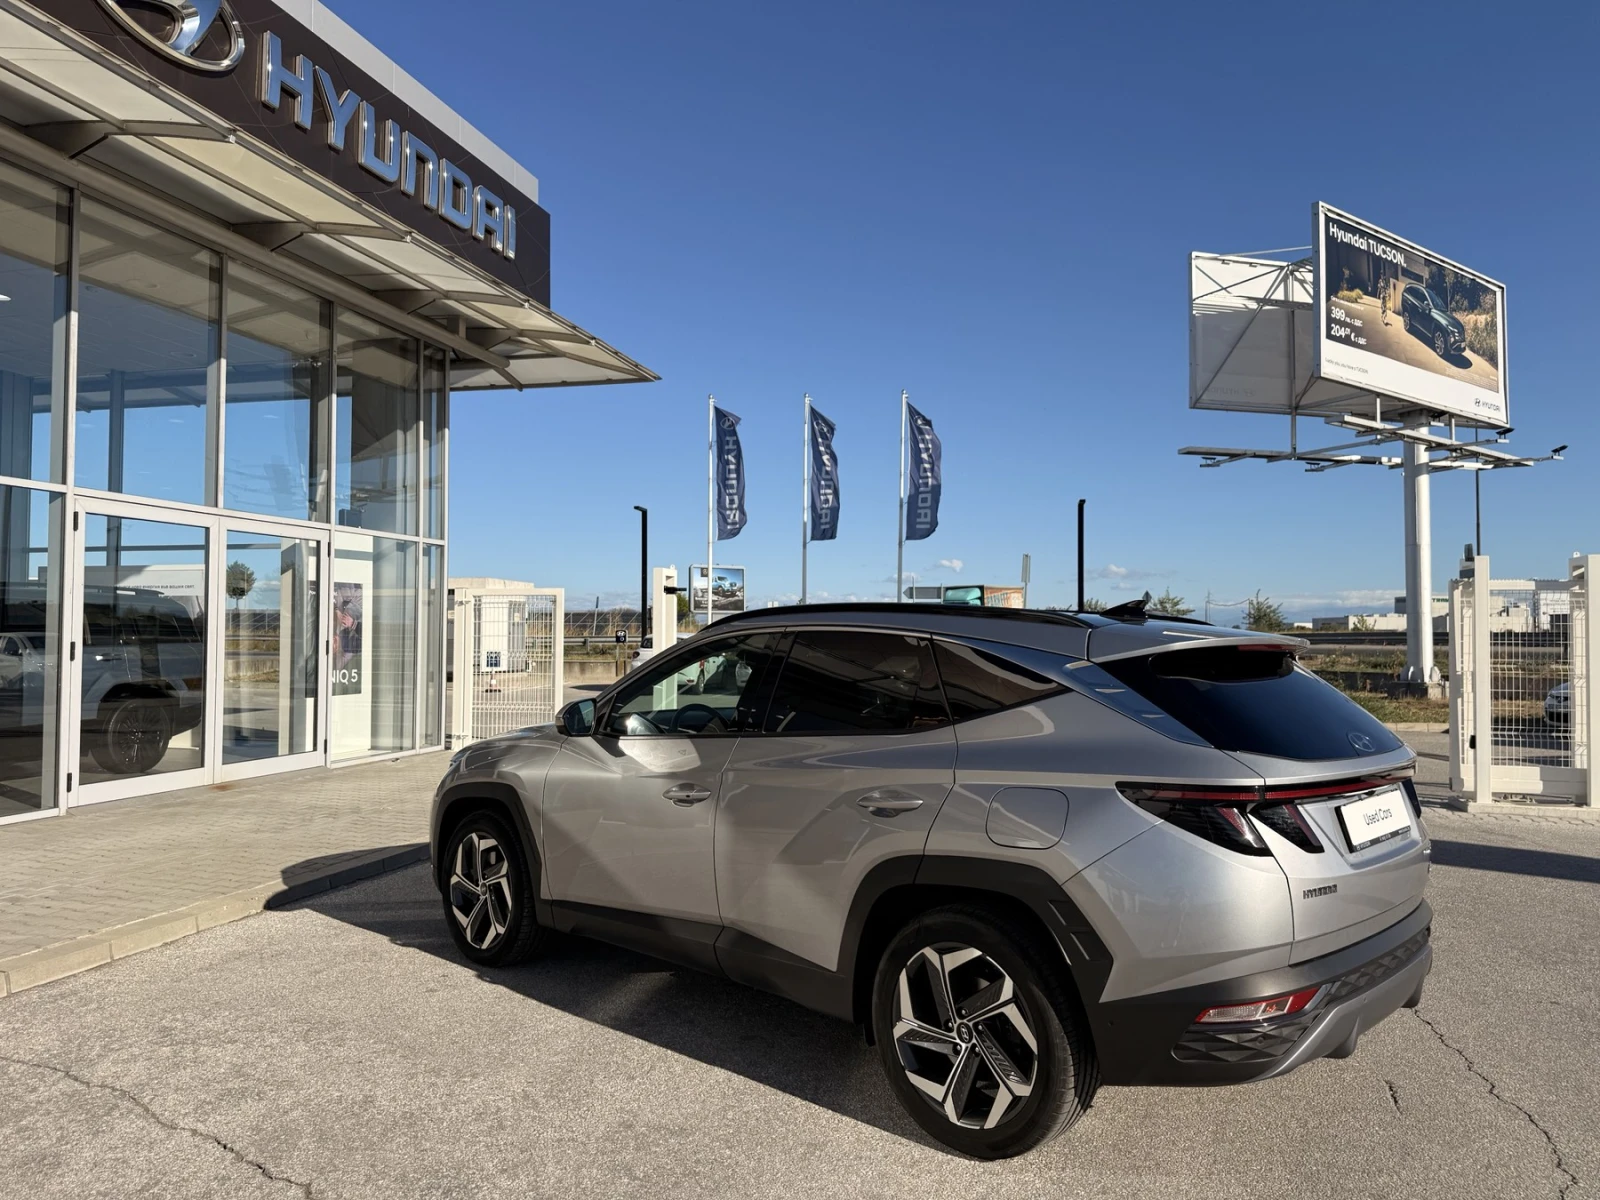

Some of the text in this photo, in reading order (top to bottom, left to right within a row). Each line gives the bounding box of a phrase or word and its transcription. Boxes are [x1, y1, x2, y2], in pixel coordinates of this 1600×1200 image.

[261, 30, 516, 260] HYUNDAI
[1329, 222, 1407, 267] Hyundai TUCSON.
[1331, 306, 1346, 321] 399
[724, 435, 740, 530] HYUNDAI
[915, 434, 933, 530] HYUNDAI
[351, 669, 359, 683] 5
[1363, 808, 1393, 826] Used Cars
[1302, 883, 1338, 900] HYUNDAI
